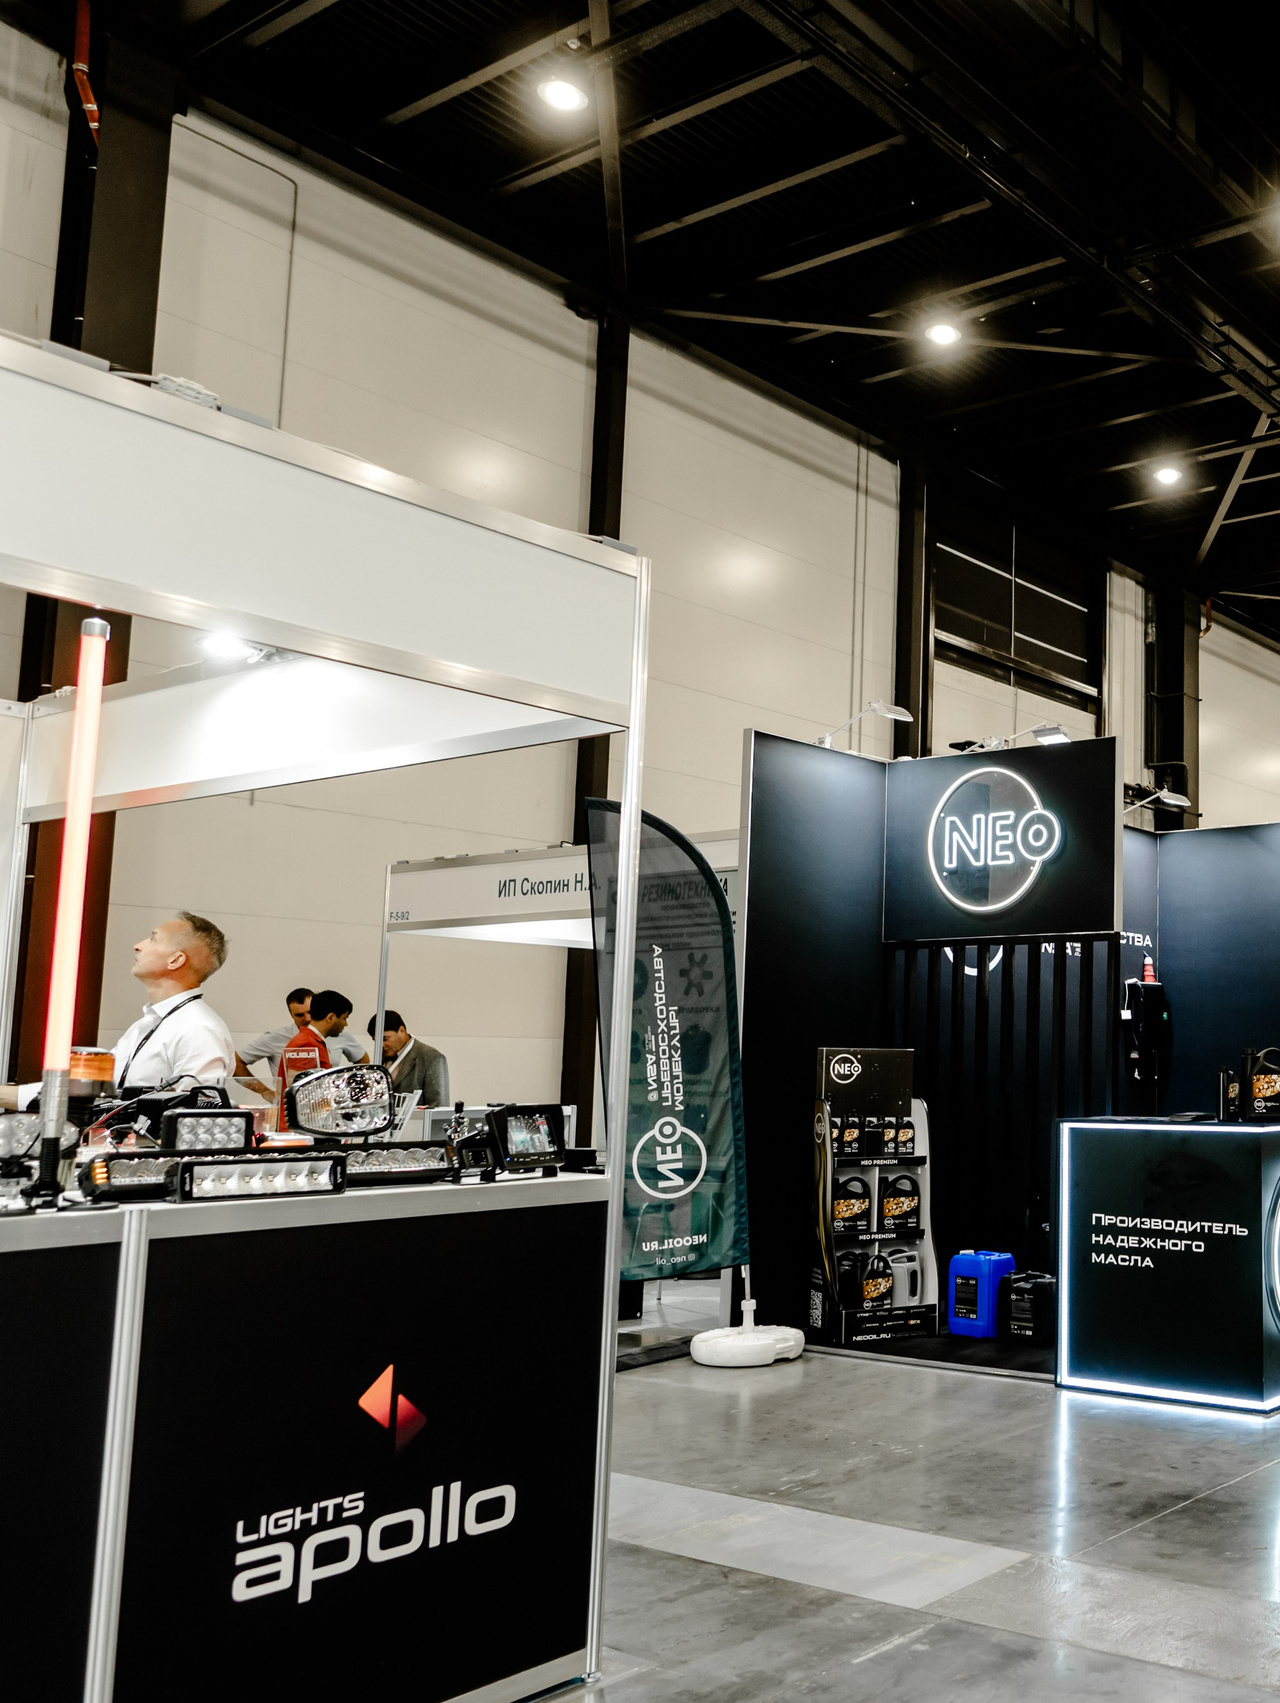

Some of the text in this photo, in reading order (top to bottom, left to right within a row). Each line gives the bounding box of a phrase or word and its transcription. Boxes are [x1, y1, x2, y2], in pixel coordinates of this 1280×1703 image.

[944, 808, 1061, 868] NEO
[498, 879, 516, 898] ИП
[520, 877, 569, 896] Скопин
[641, 877, 728, 902] РЕЗИНОТЕХНА
[389, 911, 410, 921] F-5-9/2
[834, 1062, 861, 1075] NEO
[1091, 1213, 1249, 1236] ПРОИЗВОДИТЕЛЬ
[1091, 1233, 1205, 1253] НАДЕЖНОГО
[1091, 1252, 1154, 1268] МАСЛА
[236, 1491, 365, 1543] LIGHTS
[231, 1480, 517, 1604] apollo
